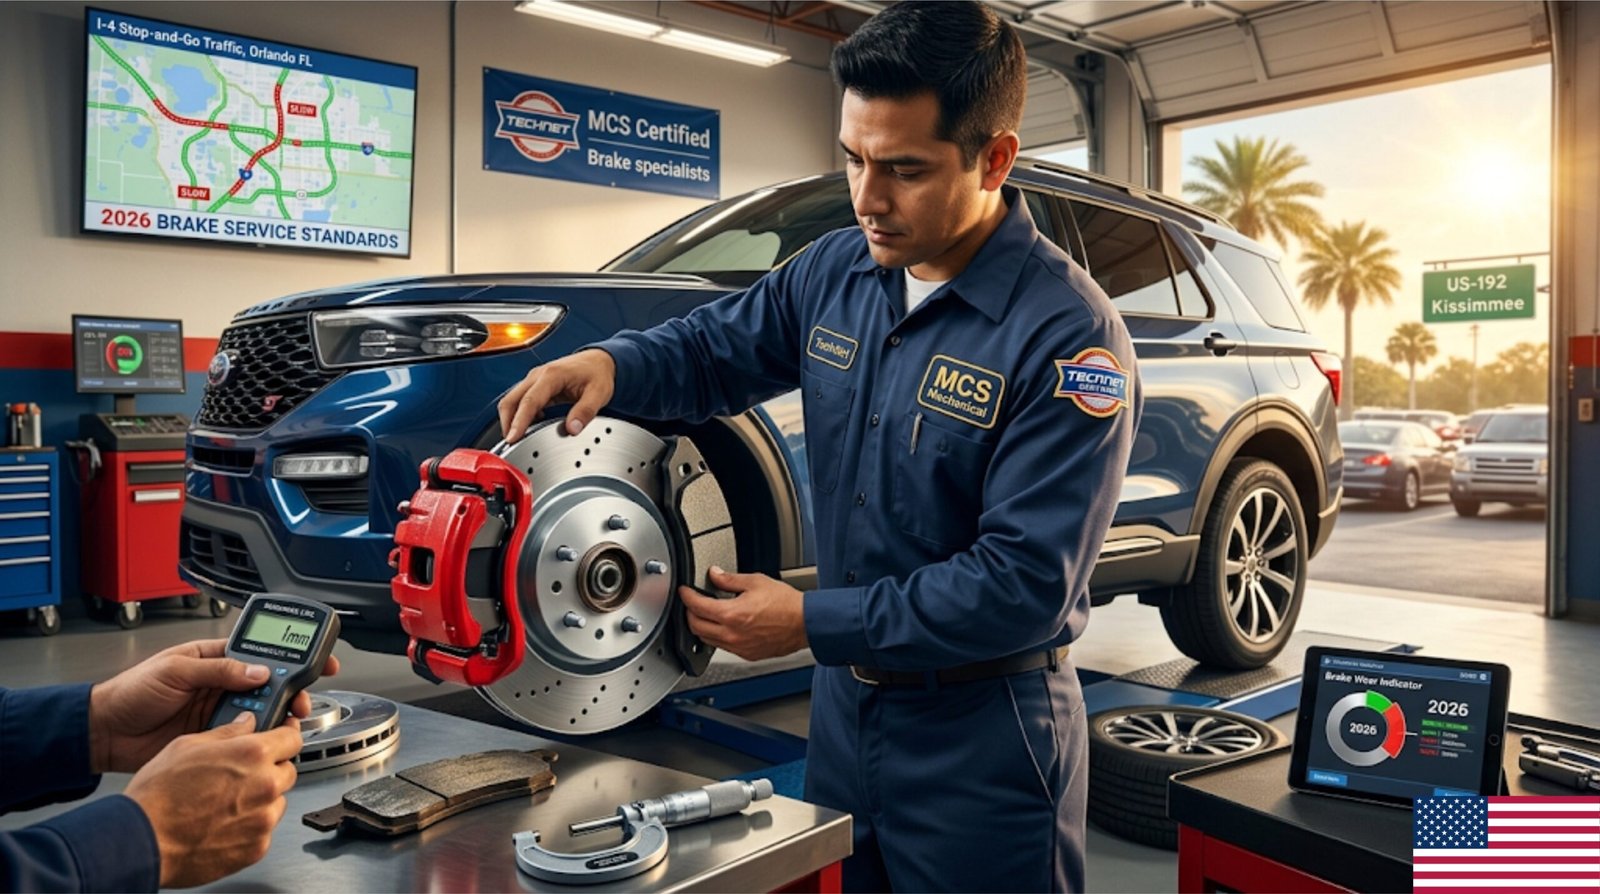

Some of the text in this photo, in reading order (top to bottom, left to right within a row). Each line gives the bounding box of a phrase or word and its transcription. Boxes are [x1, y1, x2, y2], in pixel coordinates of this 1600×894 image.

[96, 17, 313, 67] I-4 Stop-and-Go Traffic, Orlando FL
[587, 109, 711, 149] MCS Certified
[587, 148, 711, 183] Brake specialists
[180, 187, 208, 198] SLOW
[101, 208, 399, 249] 2026 BRAKE SERVICE STANDARDS
[1446, 274, 1507, 292] US-192
[1431, 297, 1525, 315] Kissimmee
[933, 365, 993, 403] MCS
[1325, 671, 1353, 683] Brake
[1379, 677, 1423, 690] Indicator
[1427, 699, 1469, 717] 2026
[1349, 722, 1378, 736] 2026
